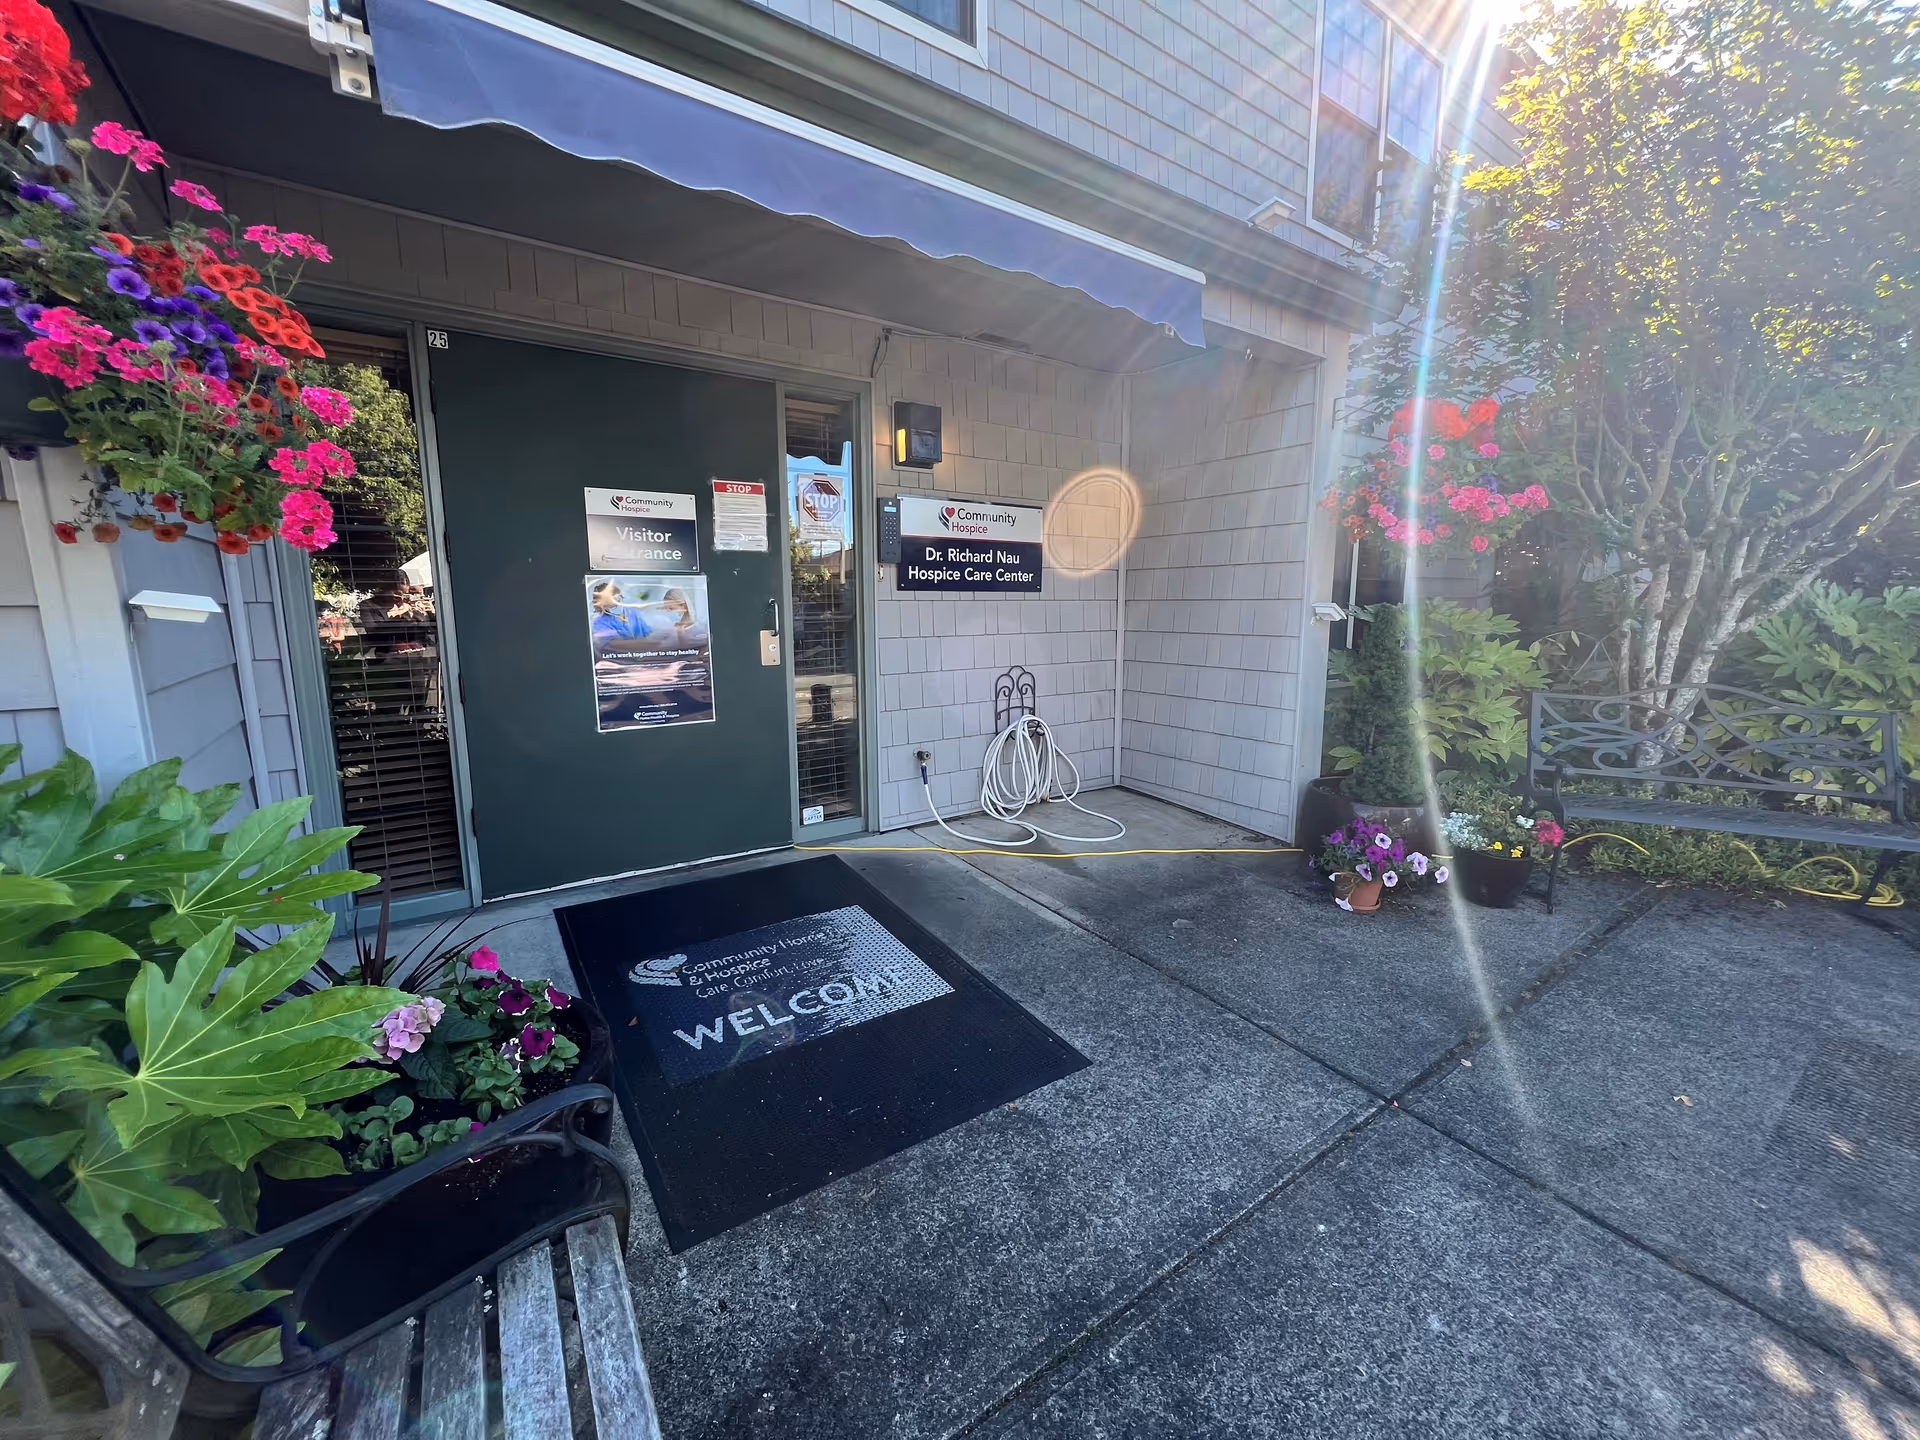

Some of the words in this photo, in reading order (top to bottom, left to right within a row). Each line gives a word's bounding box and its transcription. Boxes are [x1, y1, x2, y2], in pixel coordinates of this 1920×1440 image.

[430, 332, 446, 347] 25
[726, 484, 752, 494] STOP
[625, 496, 674, 509] Community
[805, 492, 838, 509] STOP
[621, 505, 651, 514] Hospice
[957, 508, 1017, 527] Community
[616, 526, 672, 543] Visitor
[951, 521, 989, 536] Hospice
[925, 547, 944, 562] Dr.
[948, 548, 993, 564] Richard
[996, 550, 1020, 565] Nau
[908, 565, 961, 584] Hospice
[964, 567, 992, 581] Care
[995, 568, 1034, 582] Center
[633, 651, 658, 659] together
[682, 944, 777, 974] Community
[689, 975, 703, 986] &
[704, 957, 772, 982] Hospice
[673, 964, 912, 1050] WELCOME
